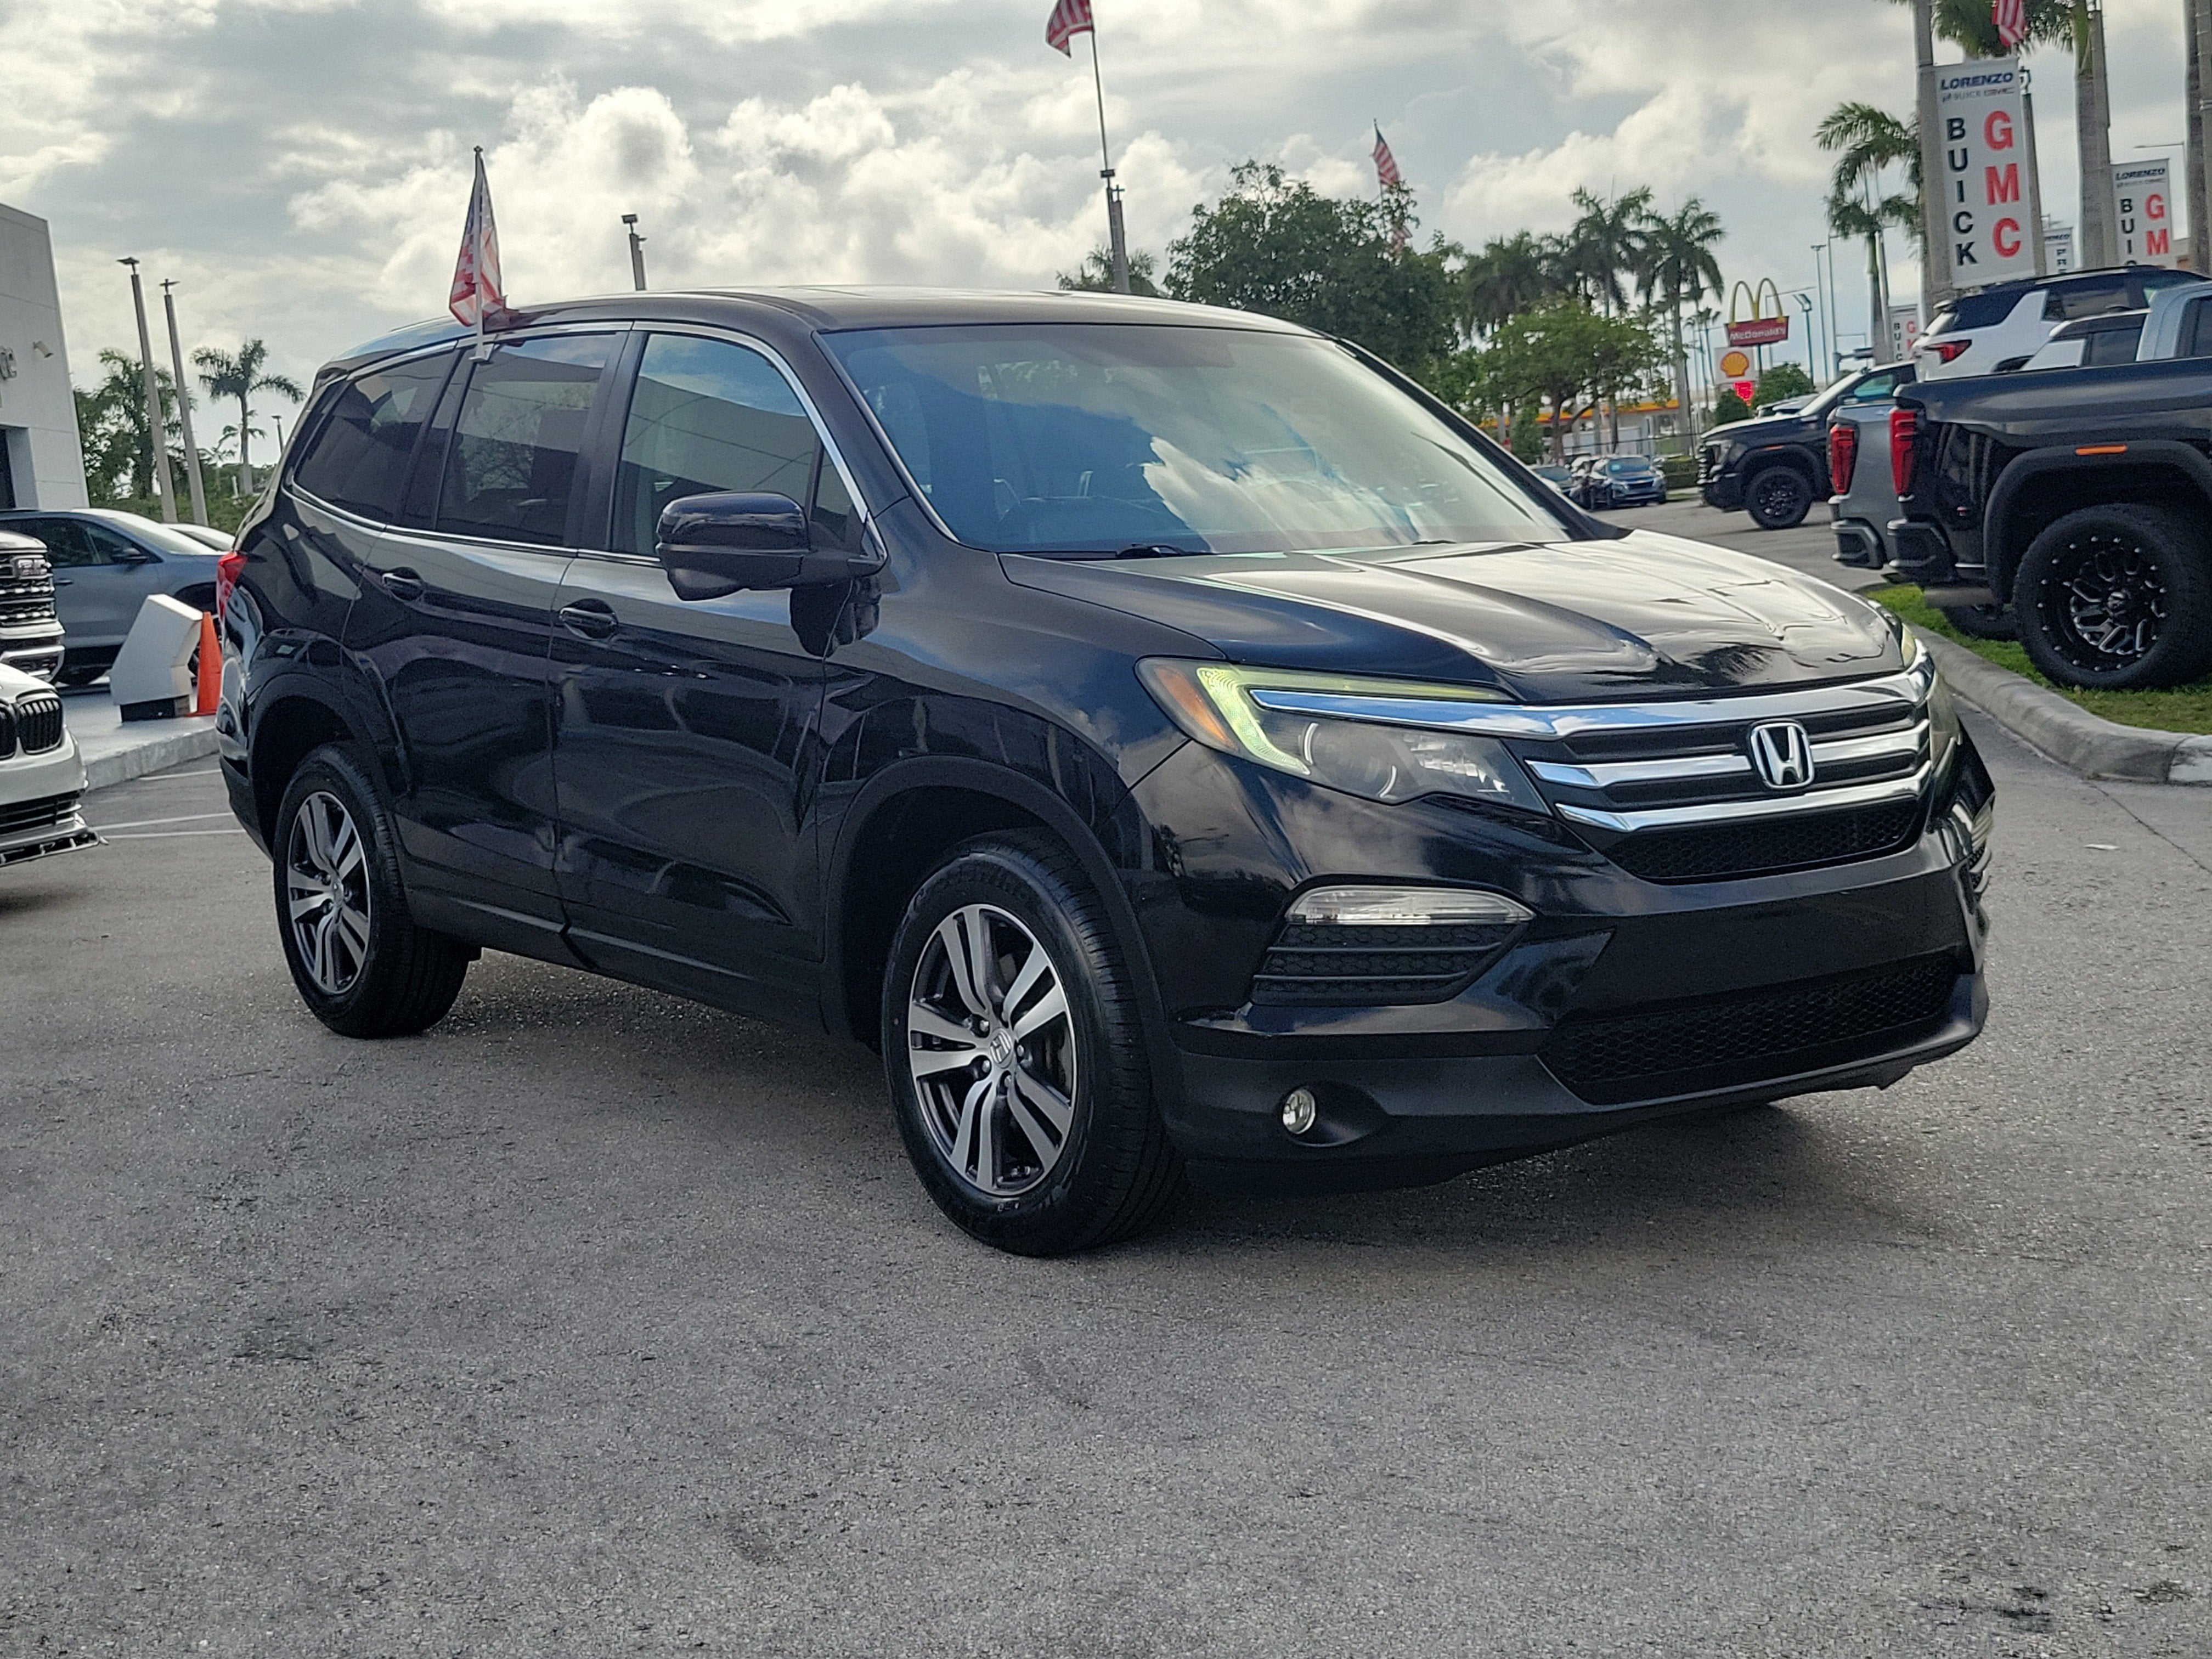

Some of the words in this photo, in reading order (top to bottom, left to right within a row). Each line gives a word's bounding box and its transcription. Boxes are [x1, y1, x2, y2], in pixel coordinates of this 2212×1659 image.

[1941, 72, 2013, 91] LORENZO
[1946, 117, 1978, 267] BUICK
[1983, 110, 2022, 257] GMC
[2115, 167, 2165, 181] LORENZO
[2145, 194, 2169, 256] GM
